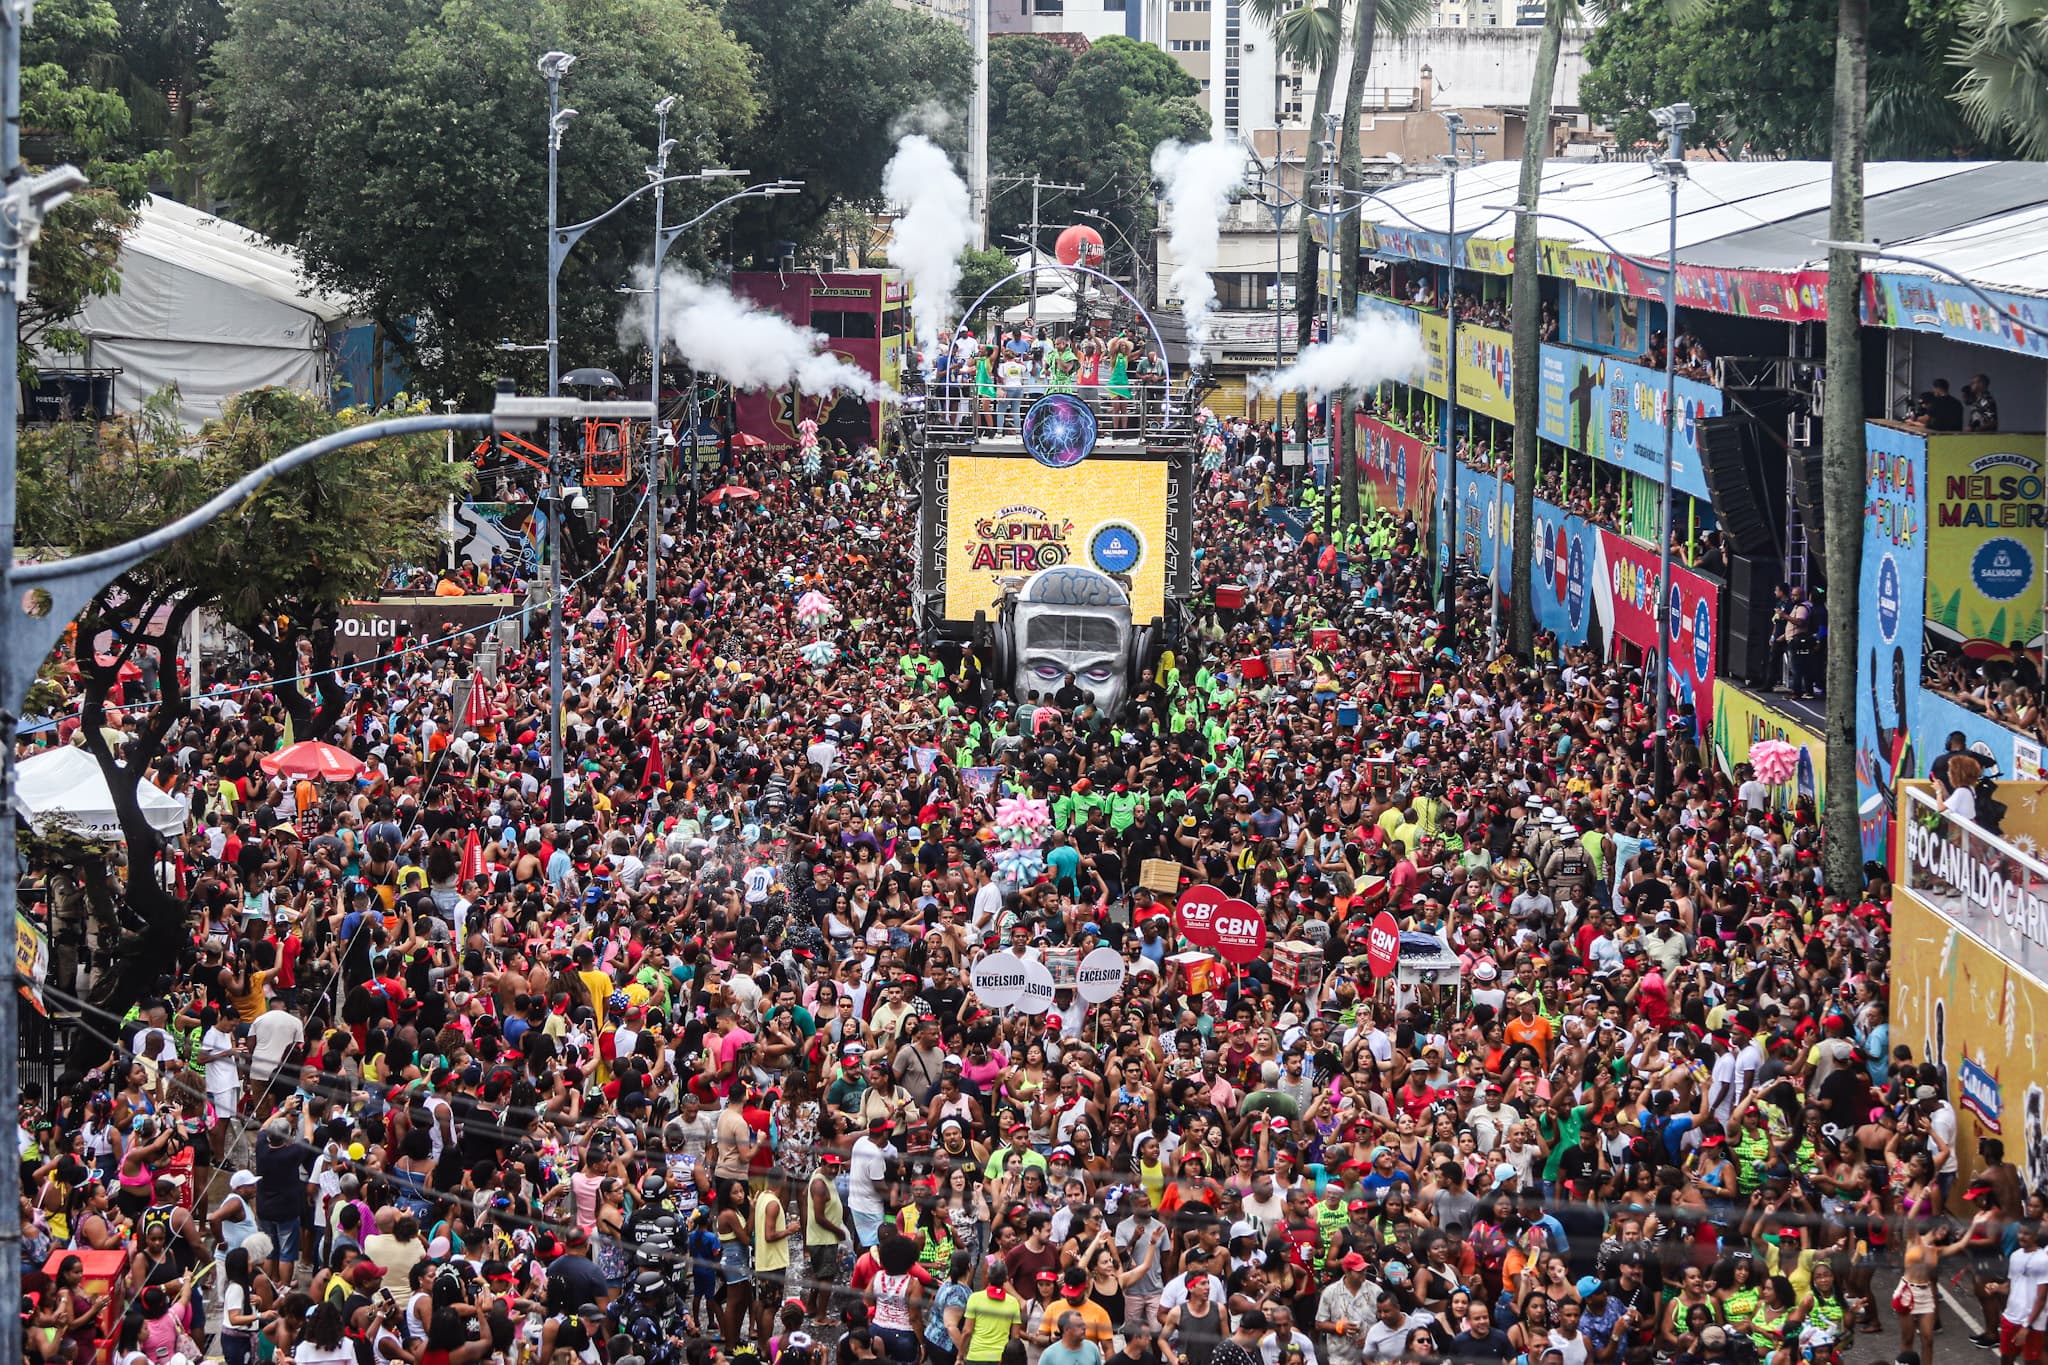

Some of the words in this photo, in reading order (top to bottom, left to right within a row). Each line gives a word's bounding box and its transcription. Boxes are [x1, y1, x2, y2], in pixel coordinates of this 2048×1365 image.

[1975, 455, 2033, 470] PASSARELA
[1946, 475, 2045, 500] NELSO
[1001, 506, 1038, 516] SALVADOR
[979, 521, 1066, 541] CAPITAL
[972, 543, 1066, 571] AFRO
[1981, 568, 2023, 577] SALVADOR
[334, 618, 414, 637] POLICI
[752, 876, 765, 891] 10
[1215, 917, 1259, 936] CBN
[1371, 927, 1397, 952] CBN
[976, 974, 1025, 987] EXCELSIOR
[1079, 969, 1121, 982] EXCELSIOR
[1024, 982, 1052, 997] LSIOR
